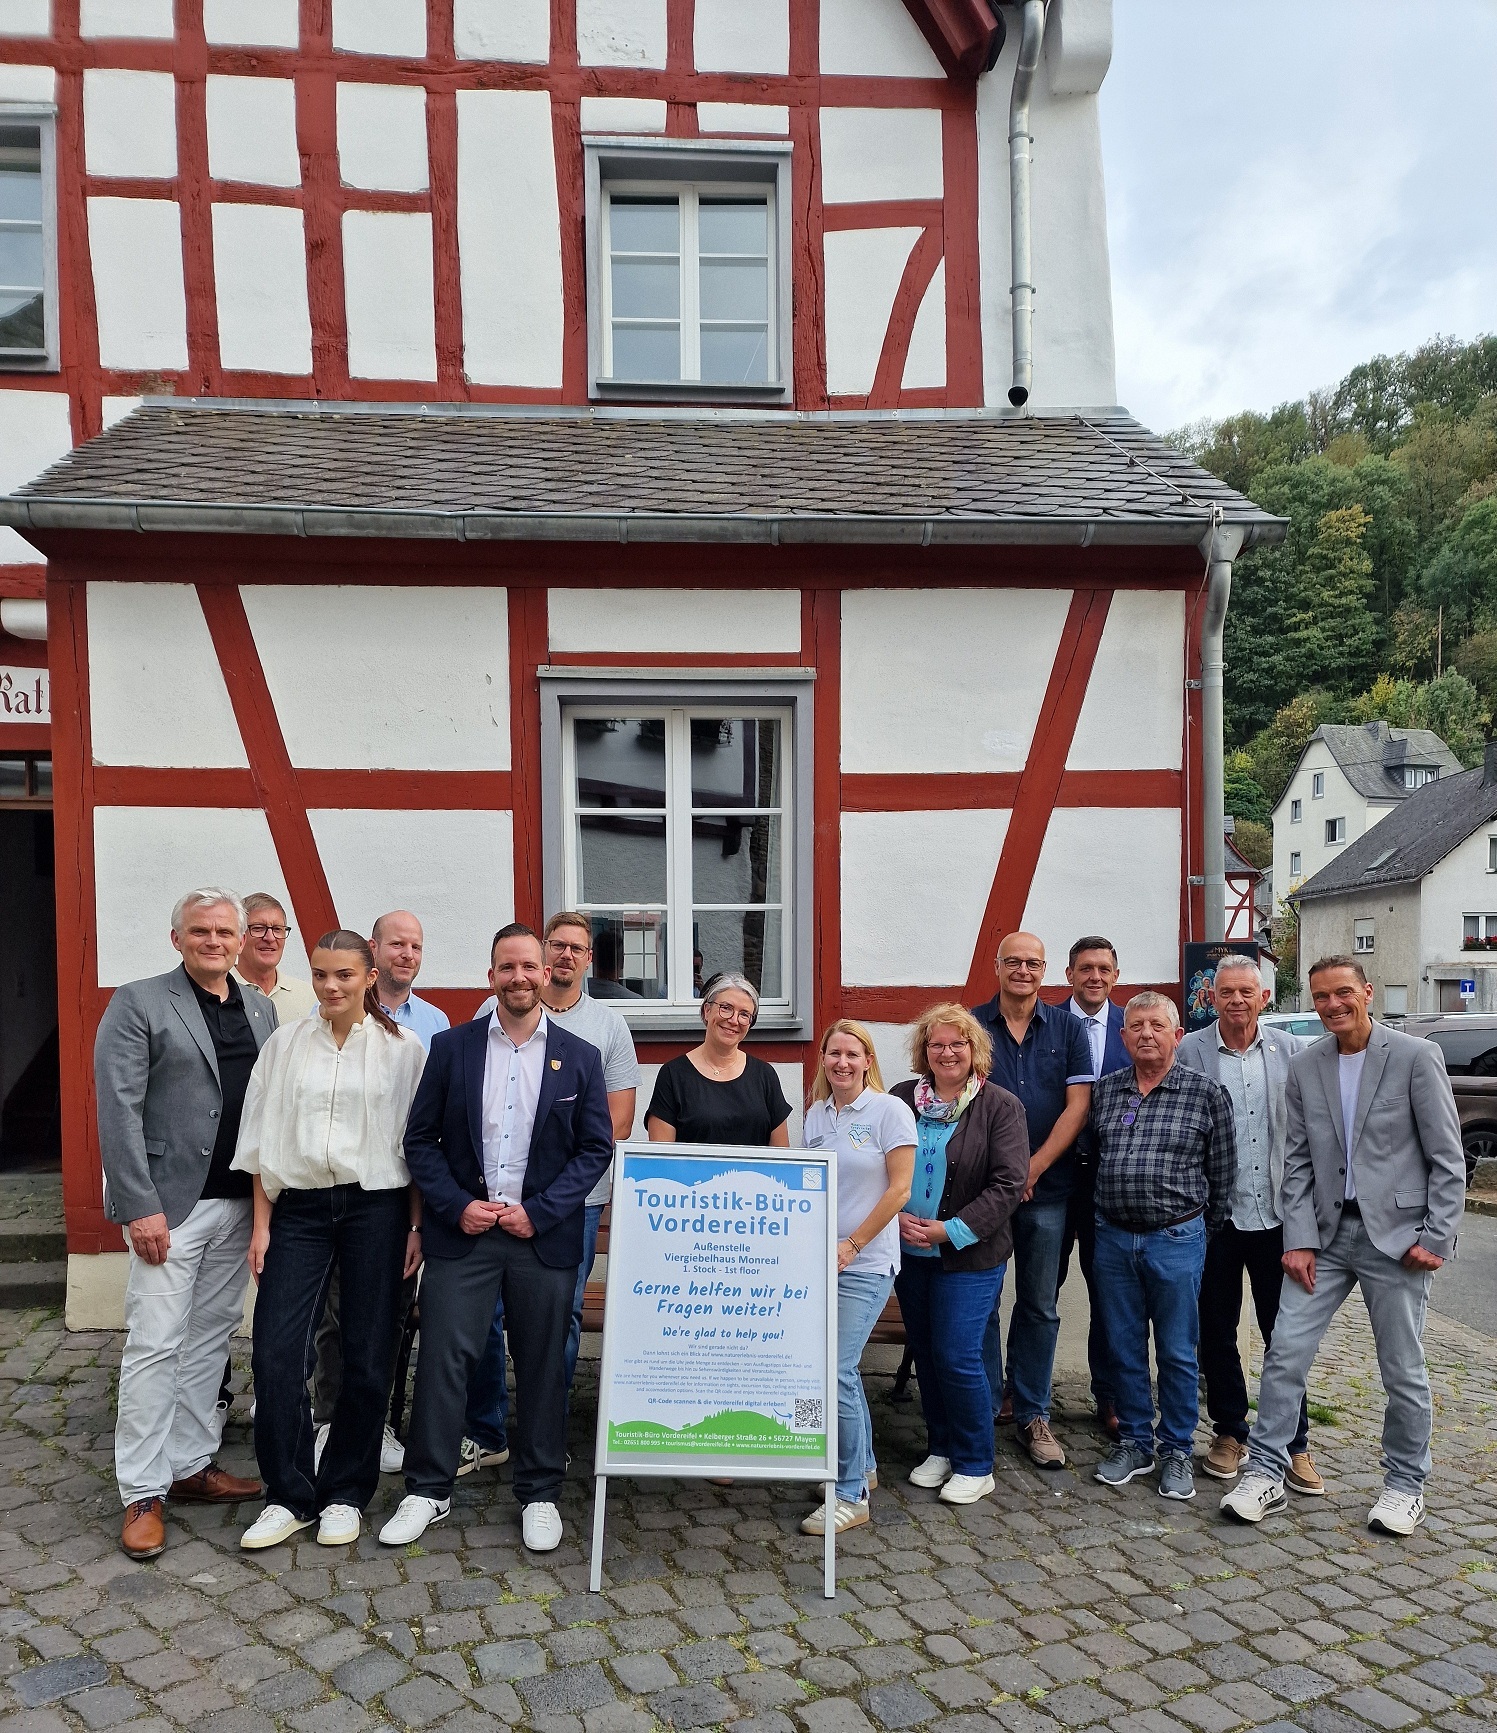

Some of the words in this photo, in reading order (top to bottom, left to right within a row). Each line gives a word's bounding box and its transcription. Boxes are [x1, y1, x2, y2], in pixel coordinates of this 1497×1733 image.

[0, 672, 51, 714] Rat
[634, 1189, 812, 1213] Touristik-Büro
[648, 1214, 789, 1236] Vordereifel
[693, 1242, 750, 1252] Außenstelle
[664, 1253, 736, 1264] Viergiebelhaus
[738, 1255, 779, 1265] Monreal
[683, 1265, 691, 1273] 1.
[693, 1265, 716, 1273] Stock
[740, 1266, 760, 1274] floor
[633, 1280, 681, 1296] Gerne
[688, 1281, 742, 1297] helfen
[750, 1284, 776, 1298] wir
[783, 1284, 809, 1300] bei
[657, 1299, 713, 1318] Fragen
[722, 1301, 782, 1317] weiter!
[662, 1326, 690, 1337] We're
[694, 1327, 716, 1340] glad
[720, 1329, 731, 1338] to
[736, 1328, 757, 1341] help
[762, 1329, 784, 1342] you!
[704, 1433, 734, 1441] Kelberger
